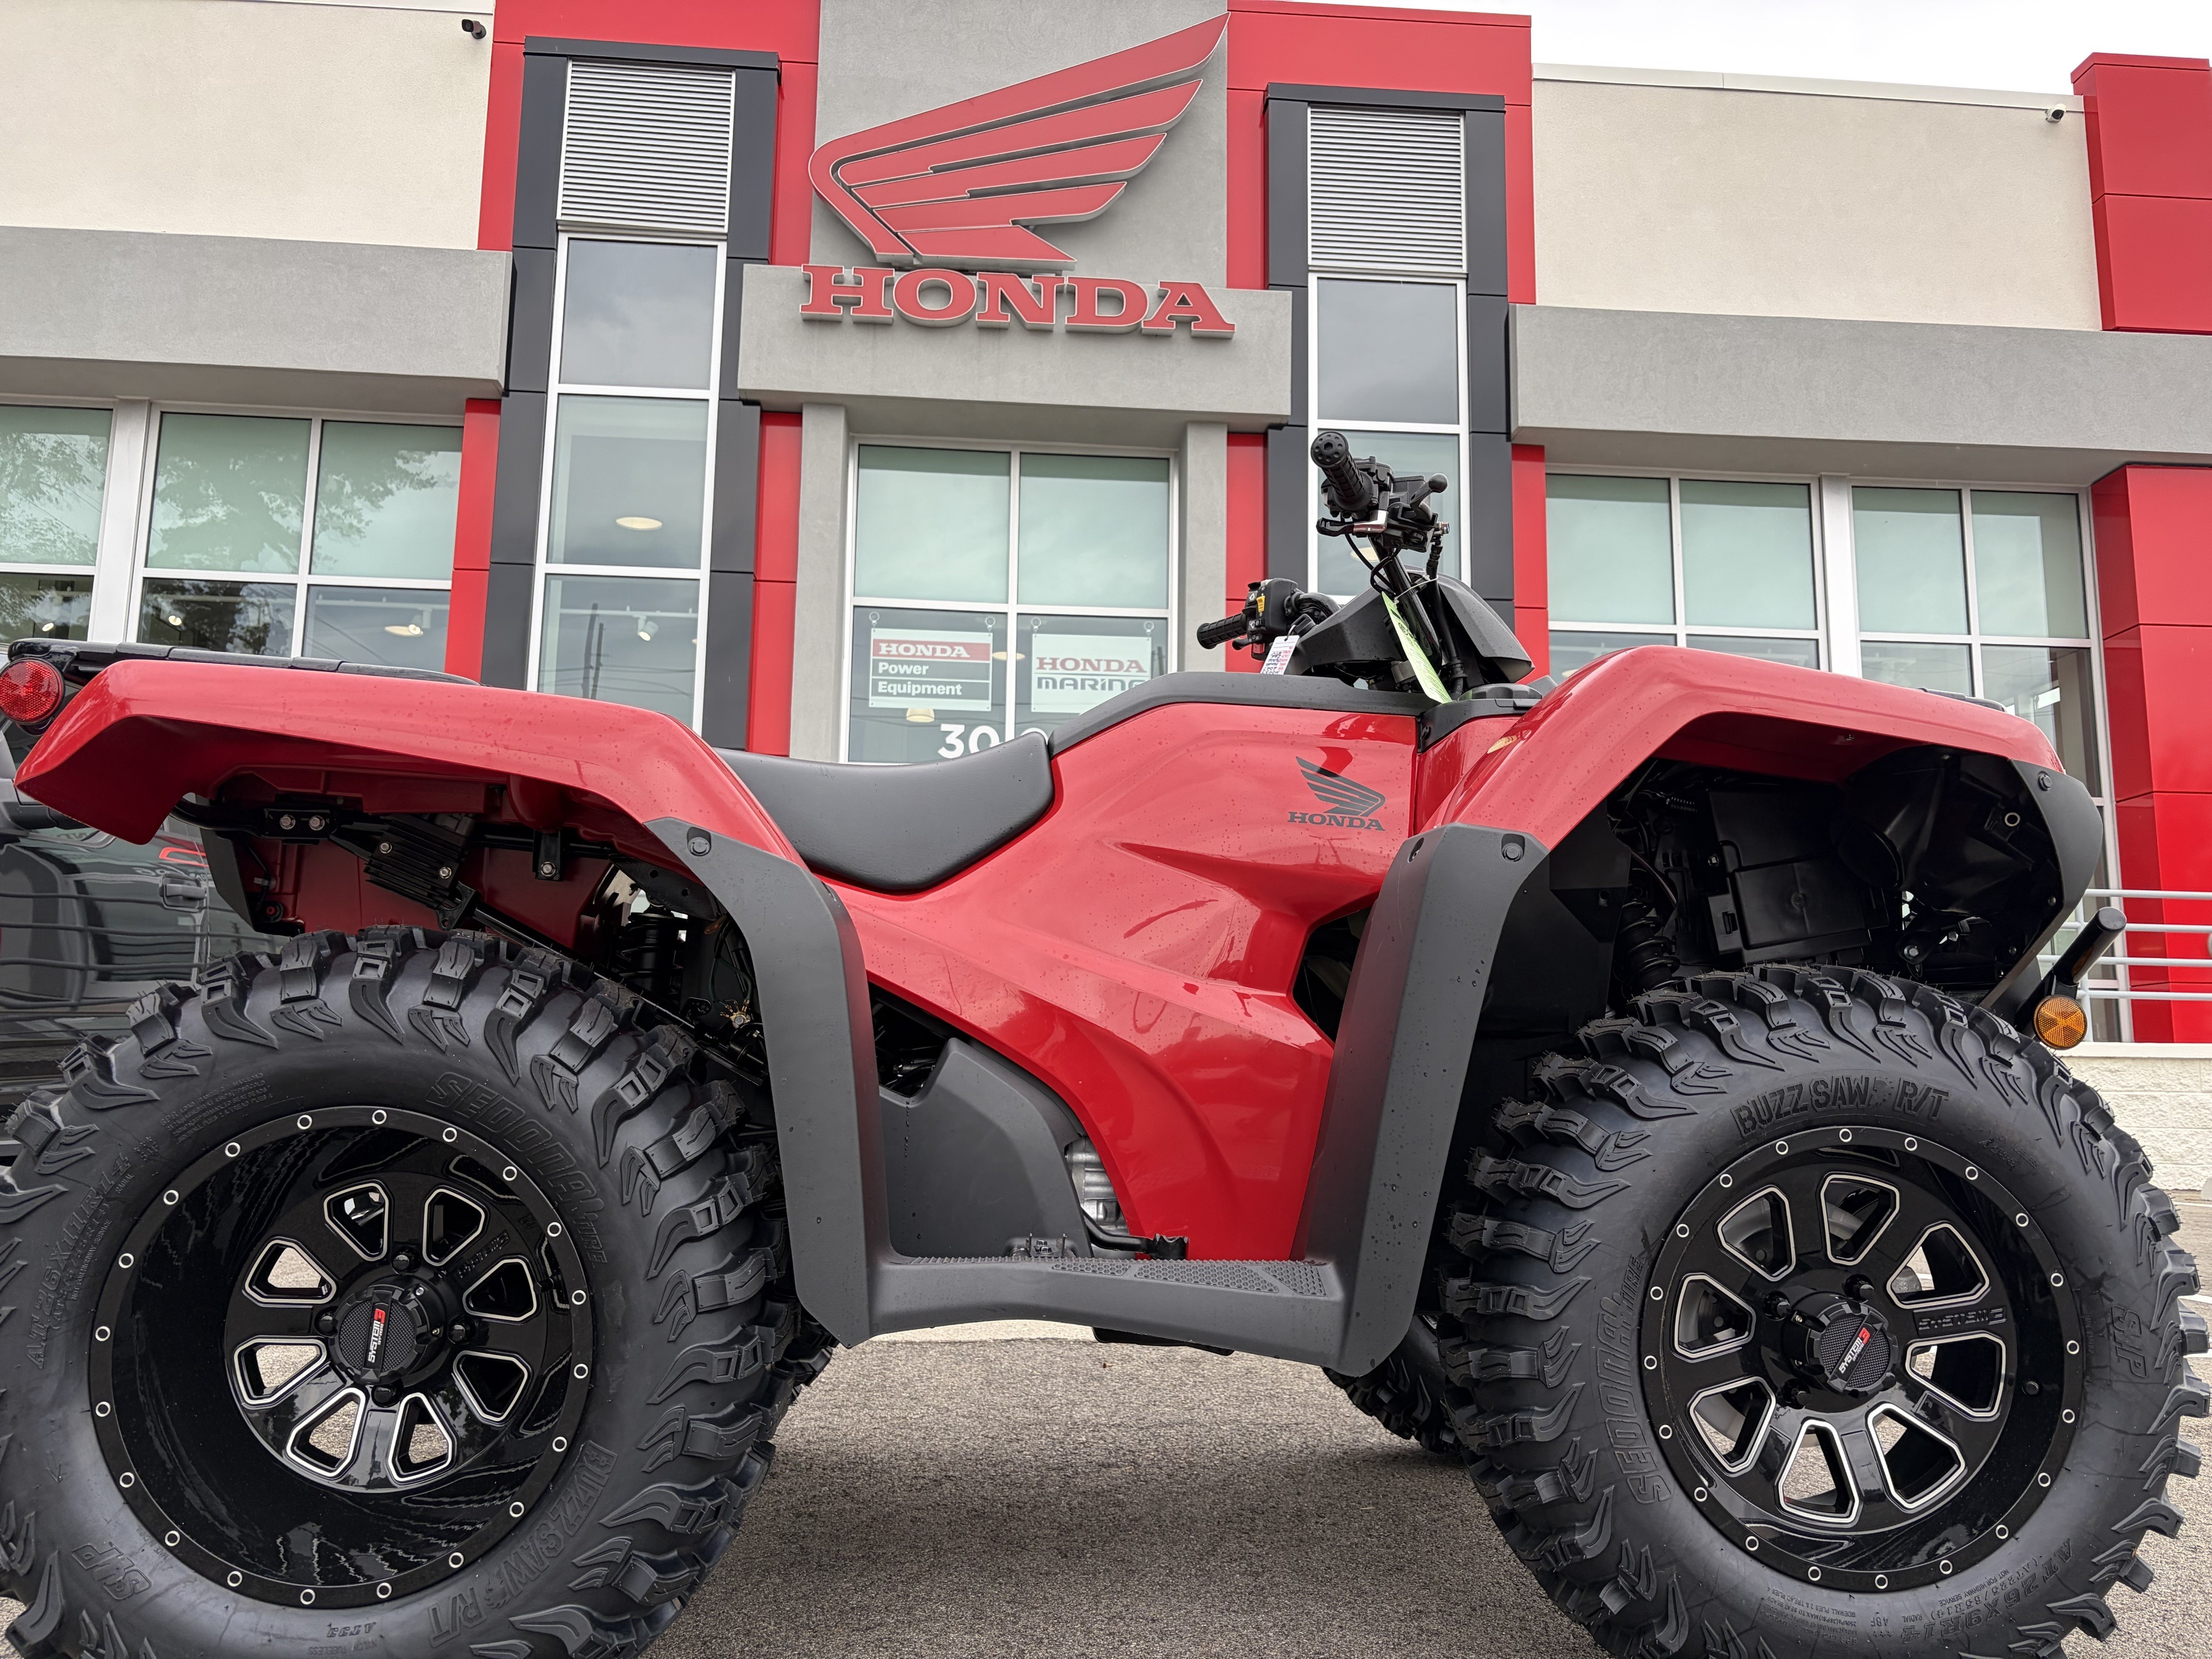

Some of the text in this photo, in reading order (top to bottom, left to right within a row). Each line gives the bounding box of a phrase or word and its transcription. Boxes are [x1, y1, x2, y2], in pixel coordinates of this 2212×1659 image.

[800, 263, 1235, 336] HONDA
[879, 643, 970, 658] HONDA
[879, 662, 928, 676] Power
[1037, 657, 1147, 673] HONDA
[879, 681, 962, 696] Equipment
[1287, 812, 1385, 831] HONDA
[1730, 1073, 1949, 1139] BUZZ SAW R/T
[426, 1071, 607, 1265] SEDONA TIRE
[116, 1173, 134, 1194] RADIAL
[70, 1218, 112, 1301] NOT FOR HIGHWAY SERVICE
[1597, 1254, 1671, 1503] SEDONA TIRE
[428, 1440, 618, 1647] BUZZ SAW R/T
[1938, 1568, 2010, 1607] NOT FOR HIGHWAY SERVICE
[1784, 1604, 1798, 1613] SEAT
[1787, 1595, 1805, 1606] TREAD
[1815, 1605, 1829, 1613] PLIES
[1831, 1609, 1856, 1617] SIDEWALL
[1901, 1613, 1923, 1623] RADIAL
